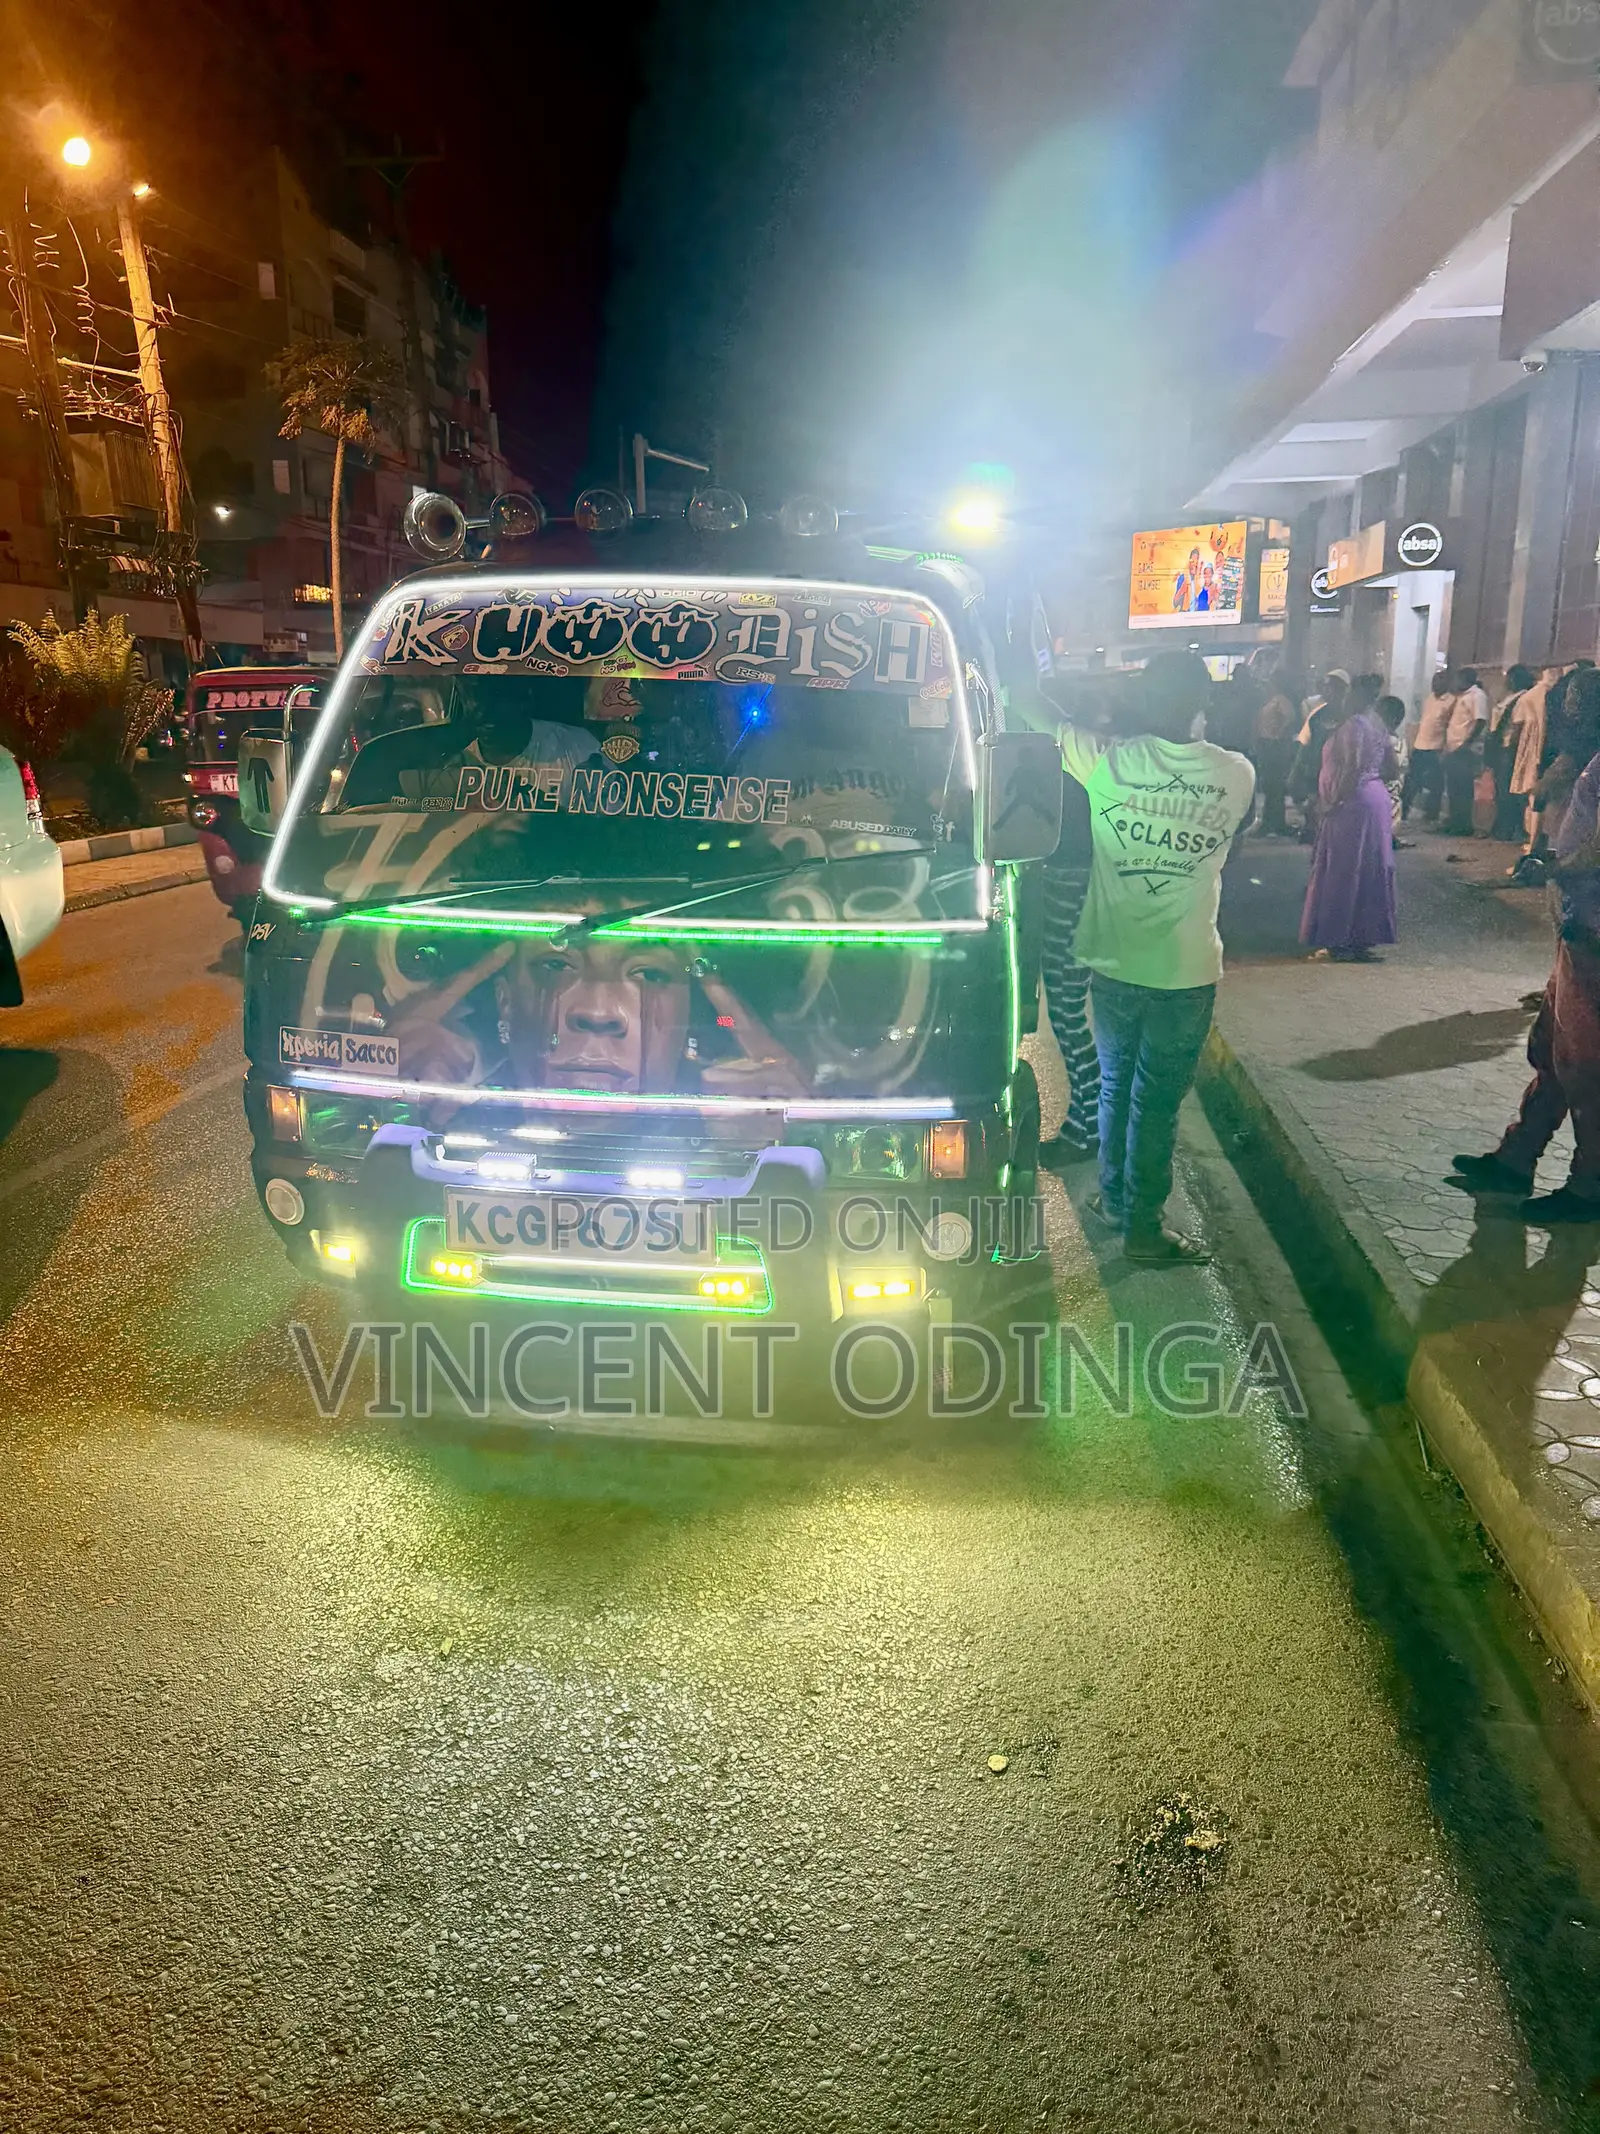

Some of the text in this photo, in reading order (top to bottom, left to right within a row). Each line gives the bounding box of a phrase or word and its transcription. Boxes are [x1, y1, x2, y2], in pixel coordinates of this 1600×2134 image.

[1545, 0, 1599, 26] abs
[1403, 536, 1437, 551] absa
[426, 591, 464, 615] TAKATA
[525, 657, 557, 675] NGK
[677, 670, 704, 680] PUMA
[222, 775, 237, 791] KT
[454, 766, 564, 812] PURE
[568, 769, 792, 825] NONSENSE
[1129, 820, 1206, 854] CLASS
[1153, 855, 1196, 873] family
[282, 1031, 398, 1065] Xperia Sacco
[456, 1200, 547, 1248] KCG
